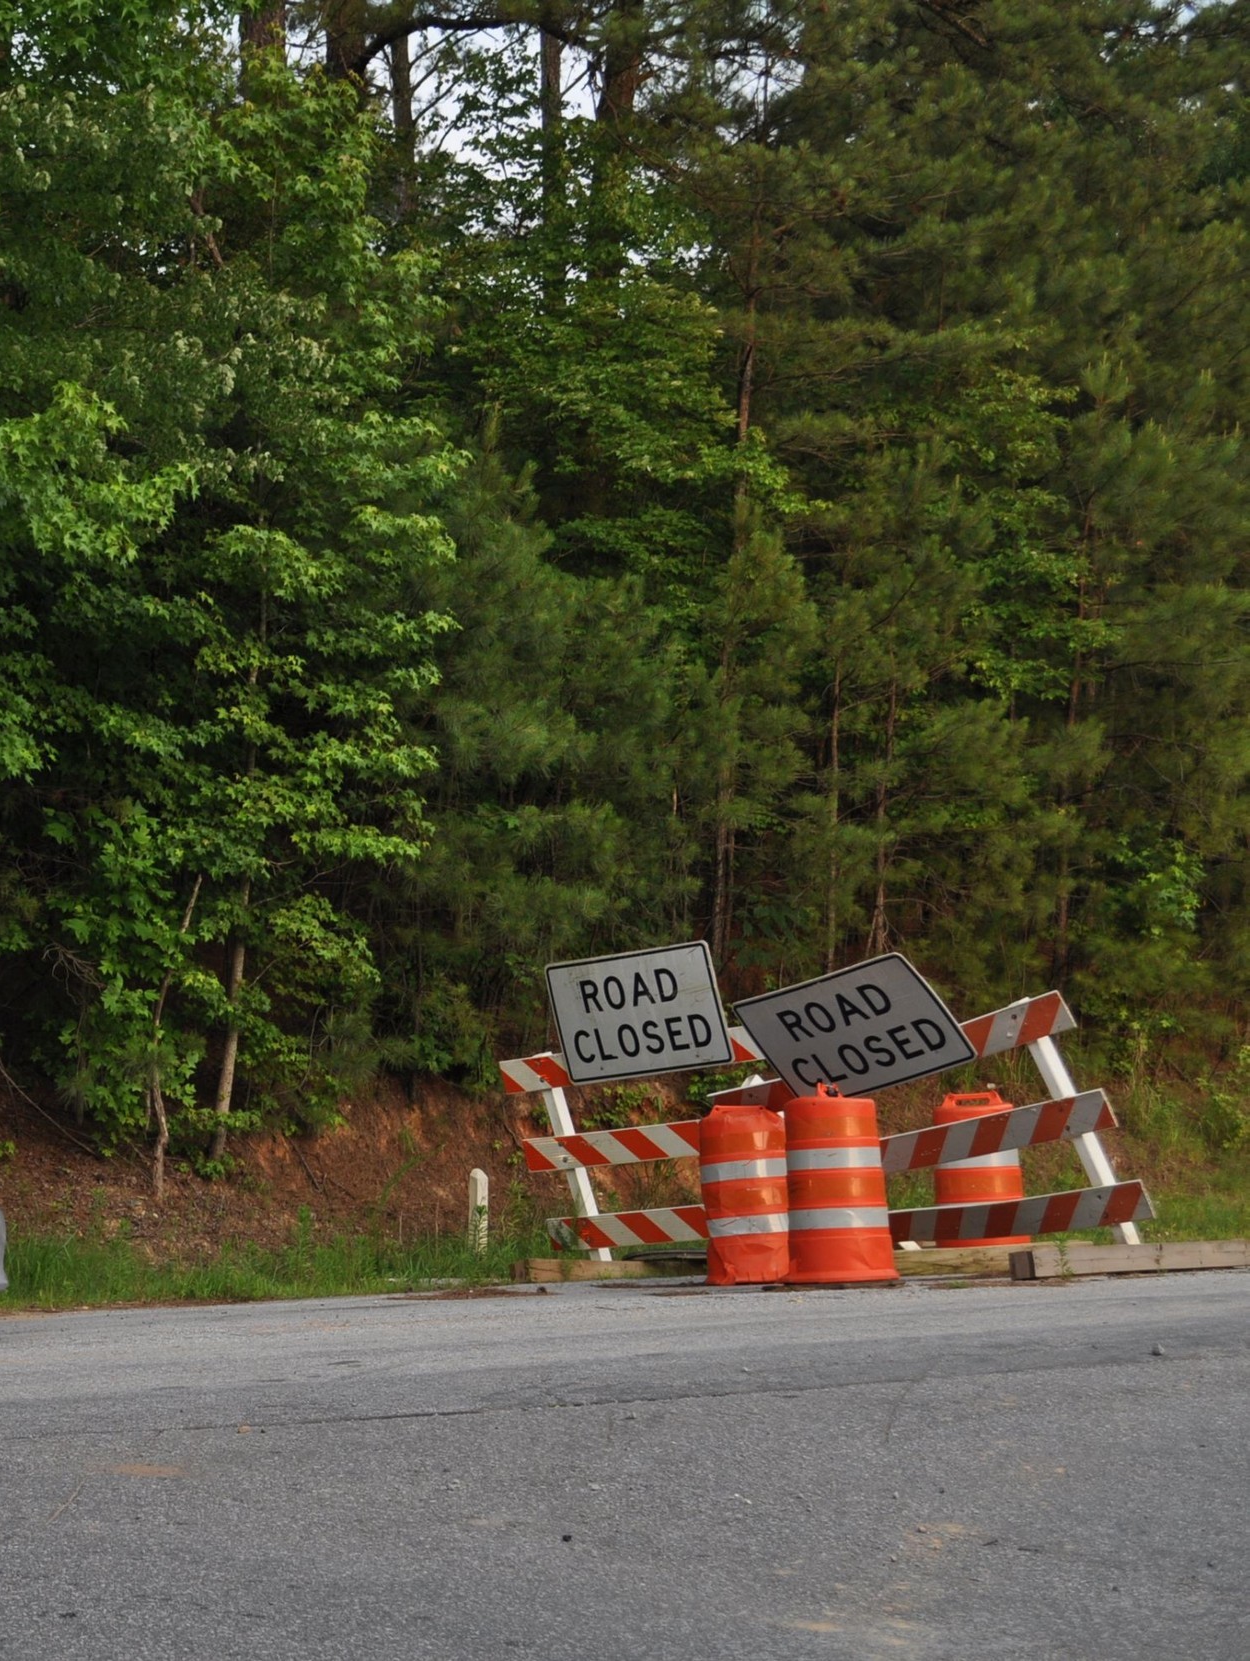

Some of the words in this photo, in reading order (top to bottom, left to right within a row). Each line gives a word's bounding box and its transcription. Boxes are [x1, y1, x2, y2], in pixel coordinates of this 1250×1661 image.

[578, 968, 678, 1014] ROAD
[776, 983, 892, 1042] ROAD
[573, 1013, 712, 1063] CLOSED
[791, 1018, 946, 1088] CLOSED
